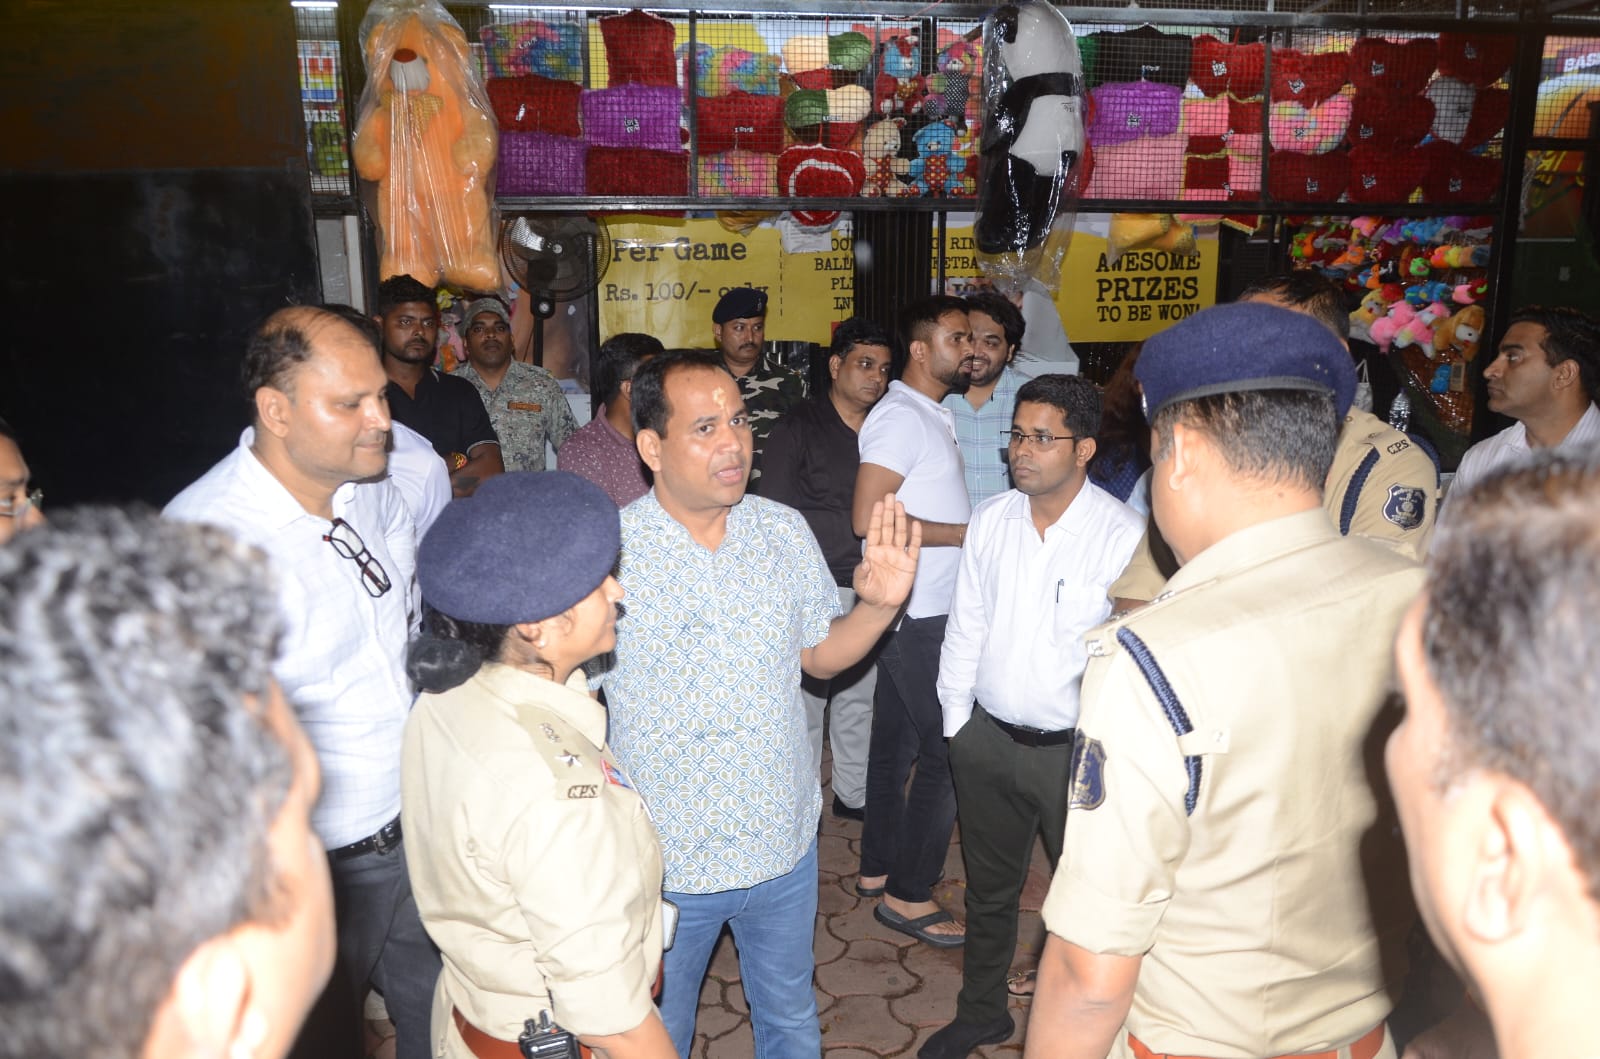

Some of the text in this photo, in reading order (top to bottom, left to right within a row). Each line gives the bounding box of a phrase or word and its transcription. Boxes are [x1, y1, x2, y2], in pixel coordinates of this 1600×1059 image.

[1563, 53, 1600, 72] BAS
[303, 109, 341, 122] MES
[612, 236, 748, 262] Per Game
[950, 237, 977, 250] RIN
[814, 256, 853, 271] BALL
[1096, 251, 1200, 272] AWESOME
[606, 284, 639, 301] Rs.
[645, 281, 711, 301] 100/-
[1096, 276, 1198, 302] PRIZES
[1097, 305, 1121, 322] TO
[1128, 304, 1151, 321] BE
